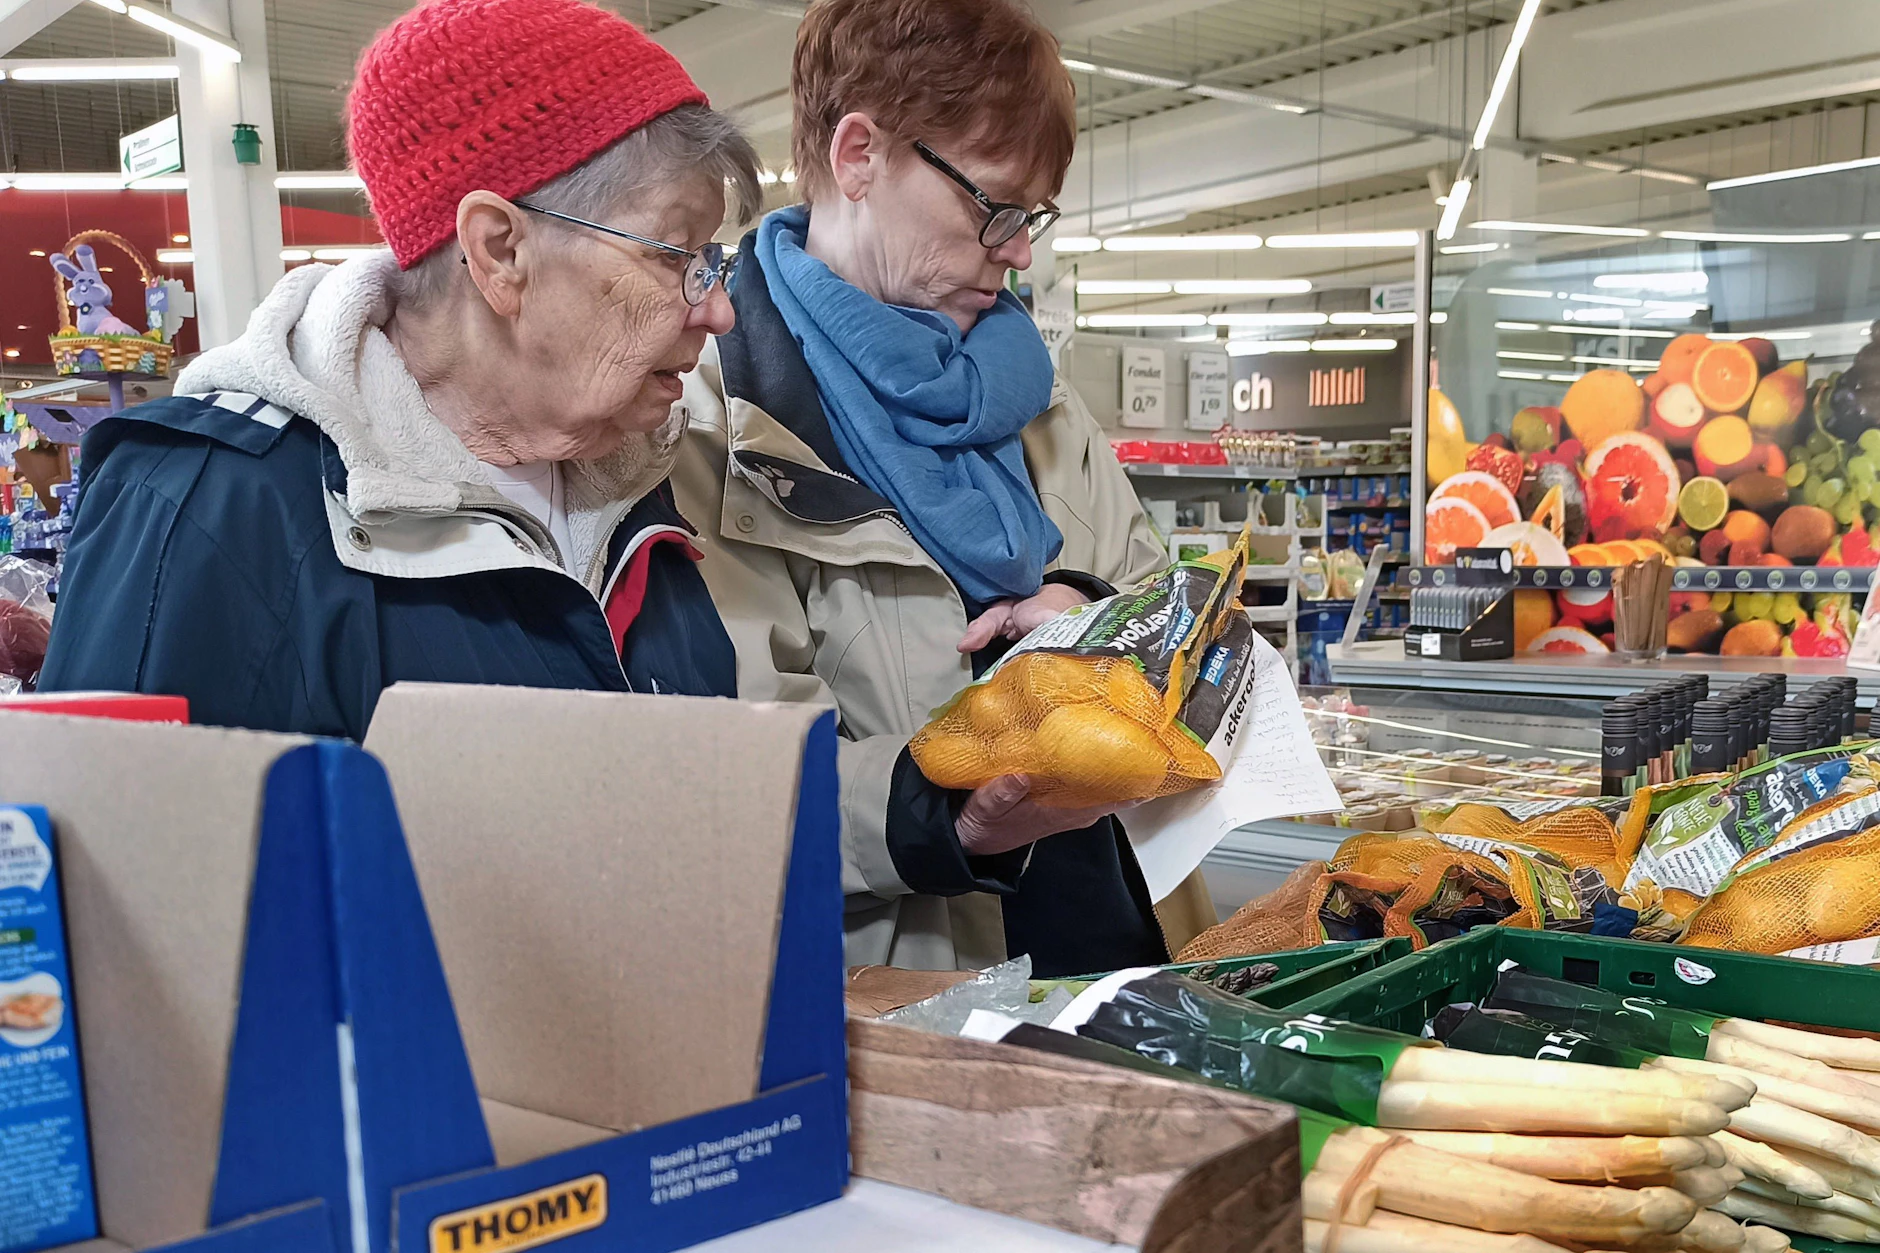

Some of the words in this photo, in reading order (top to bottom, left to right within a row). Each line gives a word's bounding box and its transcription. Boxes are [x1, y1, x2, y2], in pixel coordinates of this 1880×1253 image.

[1205, 646, 1231, 683] EDEKA
[1674, 808, 1697, 834] ERNTE
[1685, 799, 1713, 828] NEUE
[697, 1120, 780, 1159] Deutschland
[781, 1114, 802, 1133] AG
[694, 1168, 739, 1192] Neuss
[442, 1183, 597, 1251] THOMY
